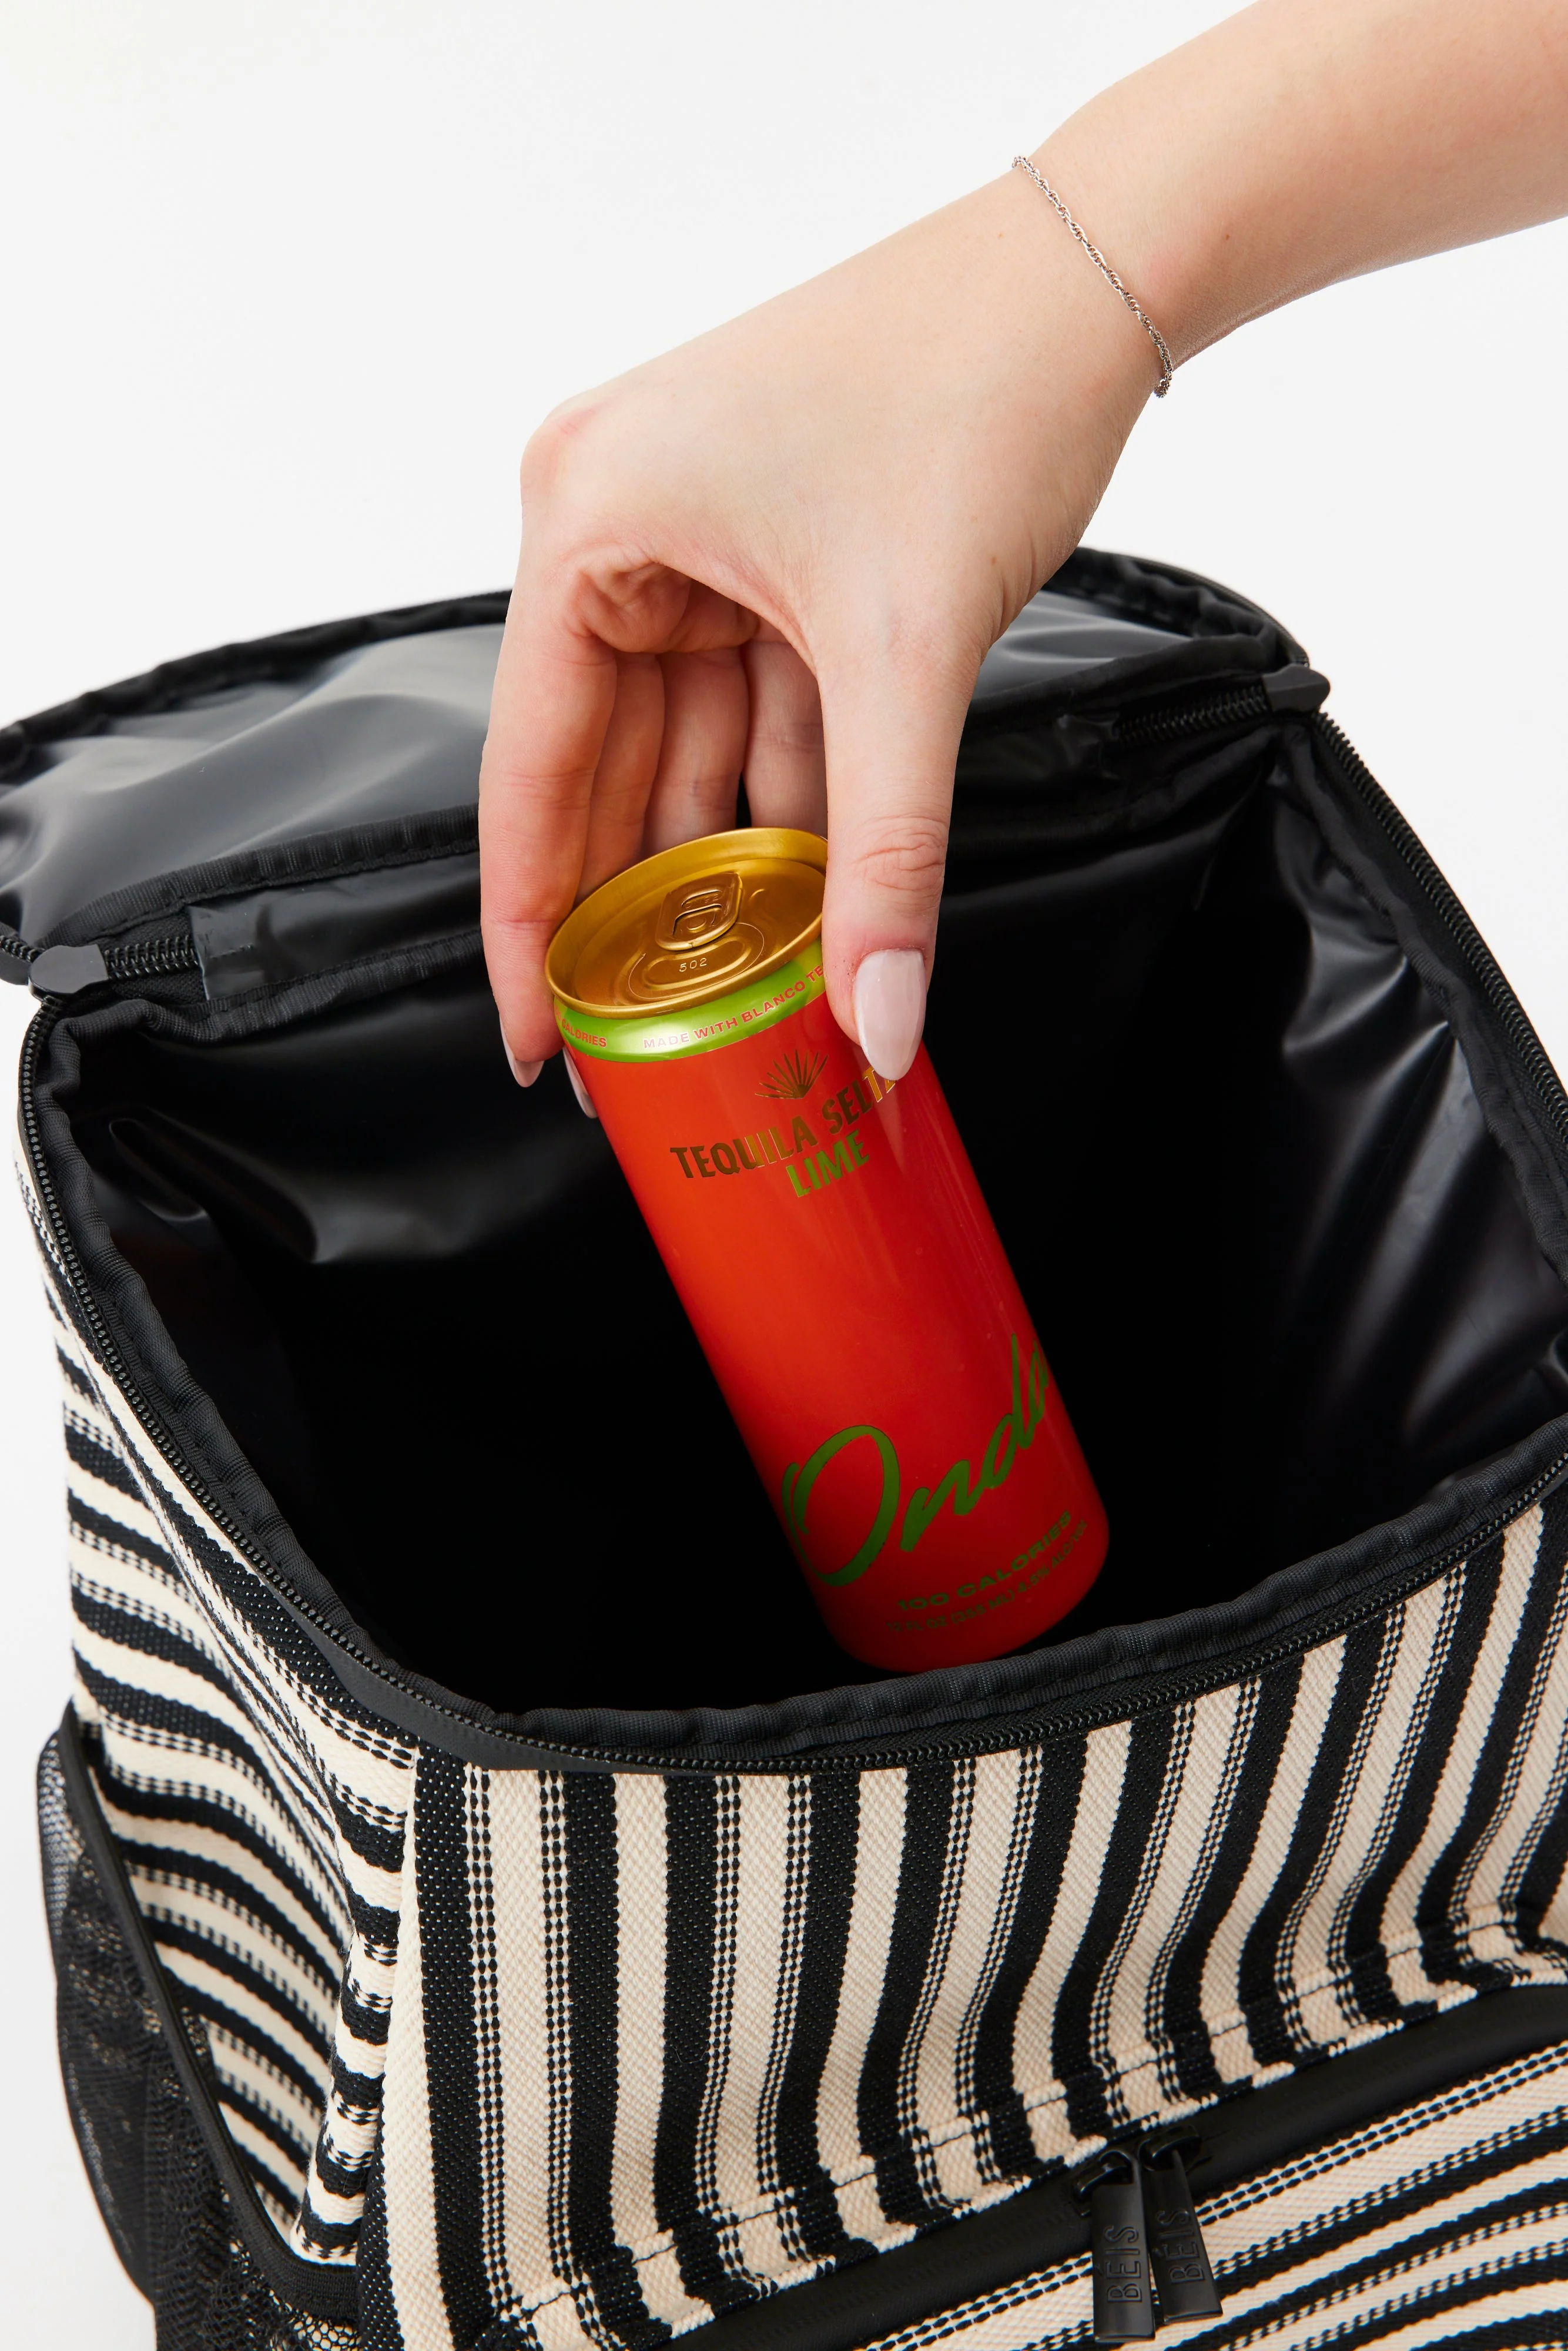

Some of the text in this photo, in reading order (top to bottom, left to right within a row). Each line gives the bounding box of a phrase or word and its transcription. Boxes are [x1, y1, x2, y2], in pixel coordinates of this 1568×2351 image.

[679, 957, 707, 972] 502
[562, 1018, 607, 1048] CALORIES
[644, 962, 823, 1049] MADE WITH BLANCO TE
[670, 1065, 896, 1178] TEQUILA SELT
[785, 1128, 870, 1197] LIME
[897, 1509, 1071, 1611] 100 CALORIES
[926, 1615, 948, 1629] OZ
[987, 1588, 1016, 1610] ML)
